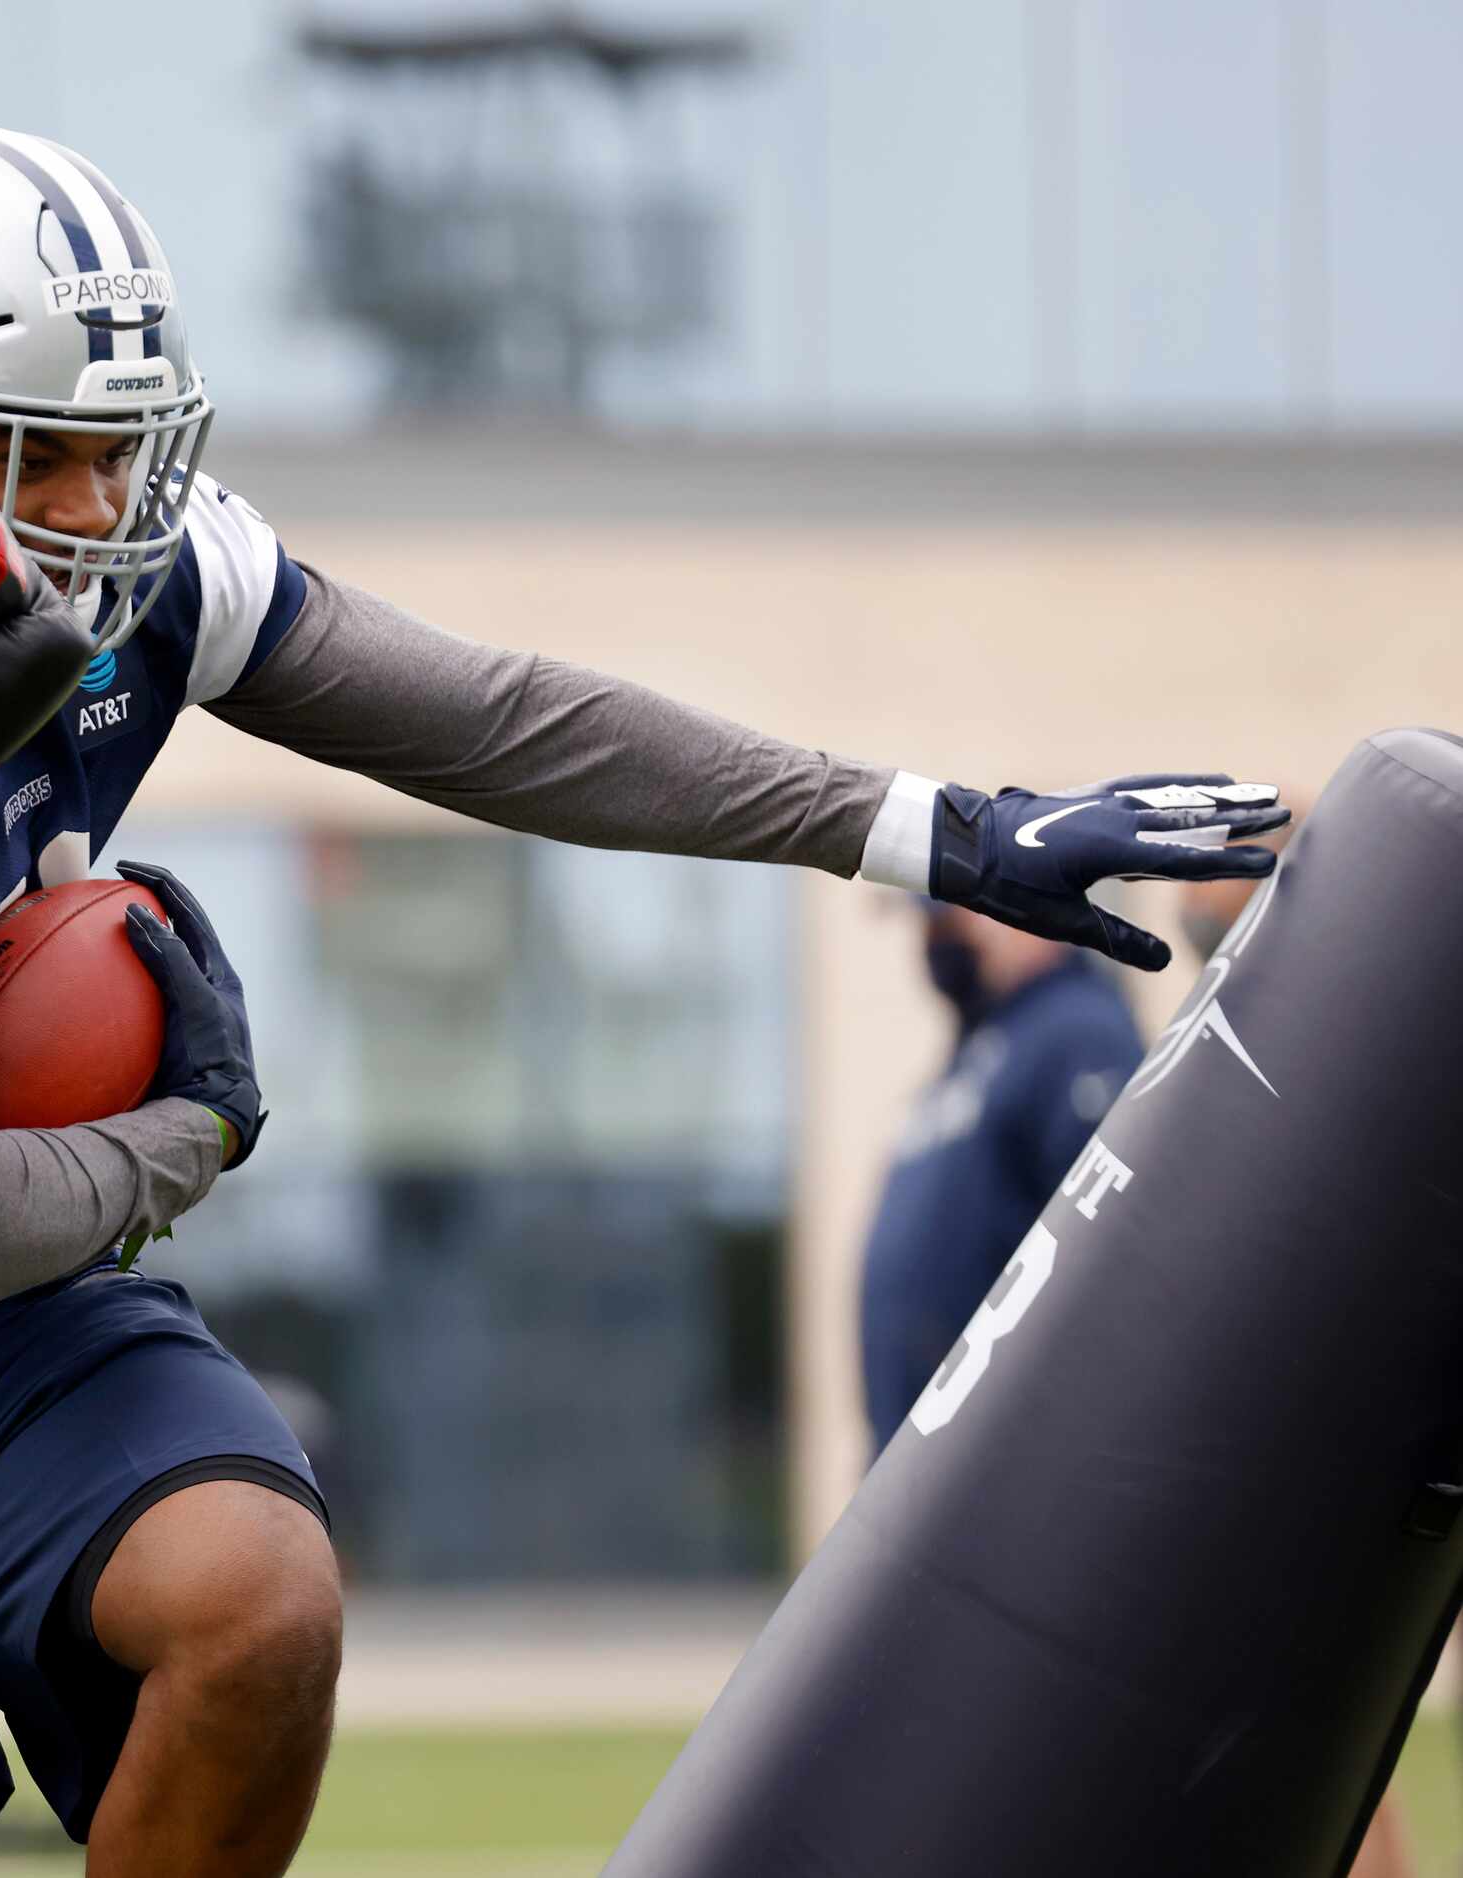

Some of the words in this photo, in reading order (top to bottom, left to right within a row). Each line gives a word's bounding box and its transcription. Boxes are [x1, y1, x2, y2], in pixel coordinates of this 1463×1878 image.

[52, 272, 171, 309] PARSONS
[106, 375, 164, 392] COWBOYS
[77, 691, 132, 737] AT&T
